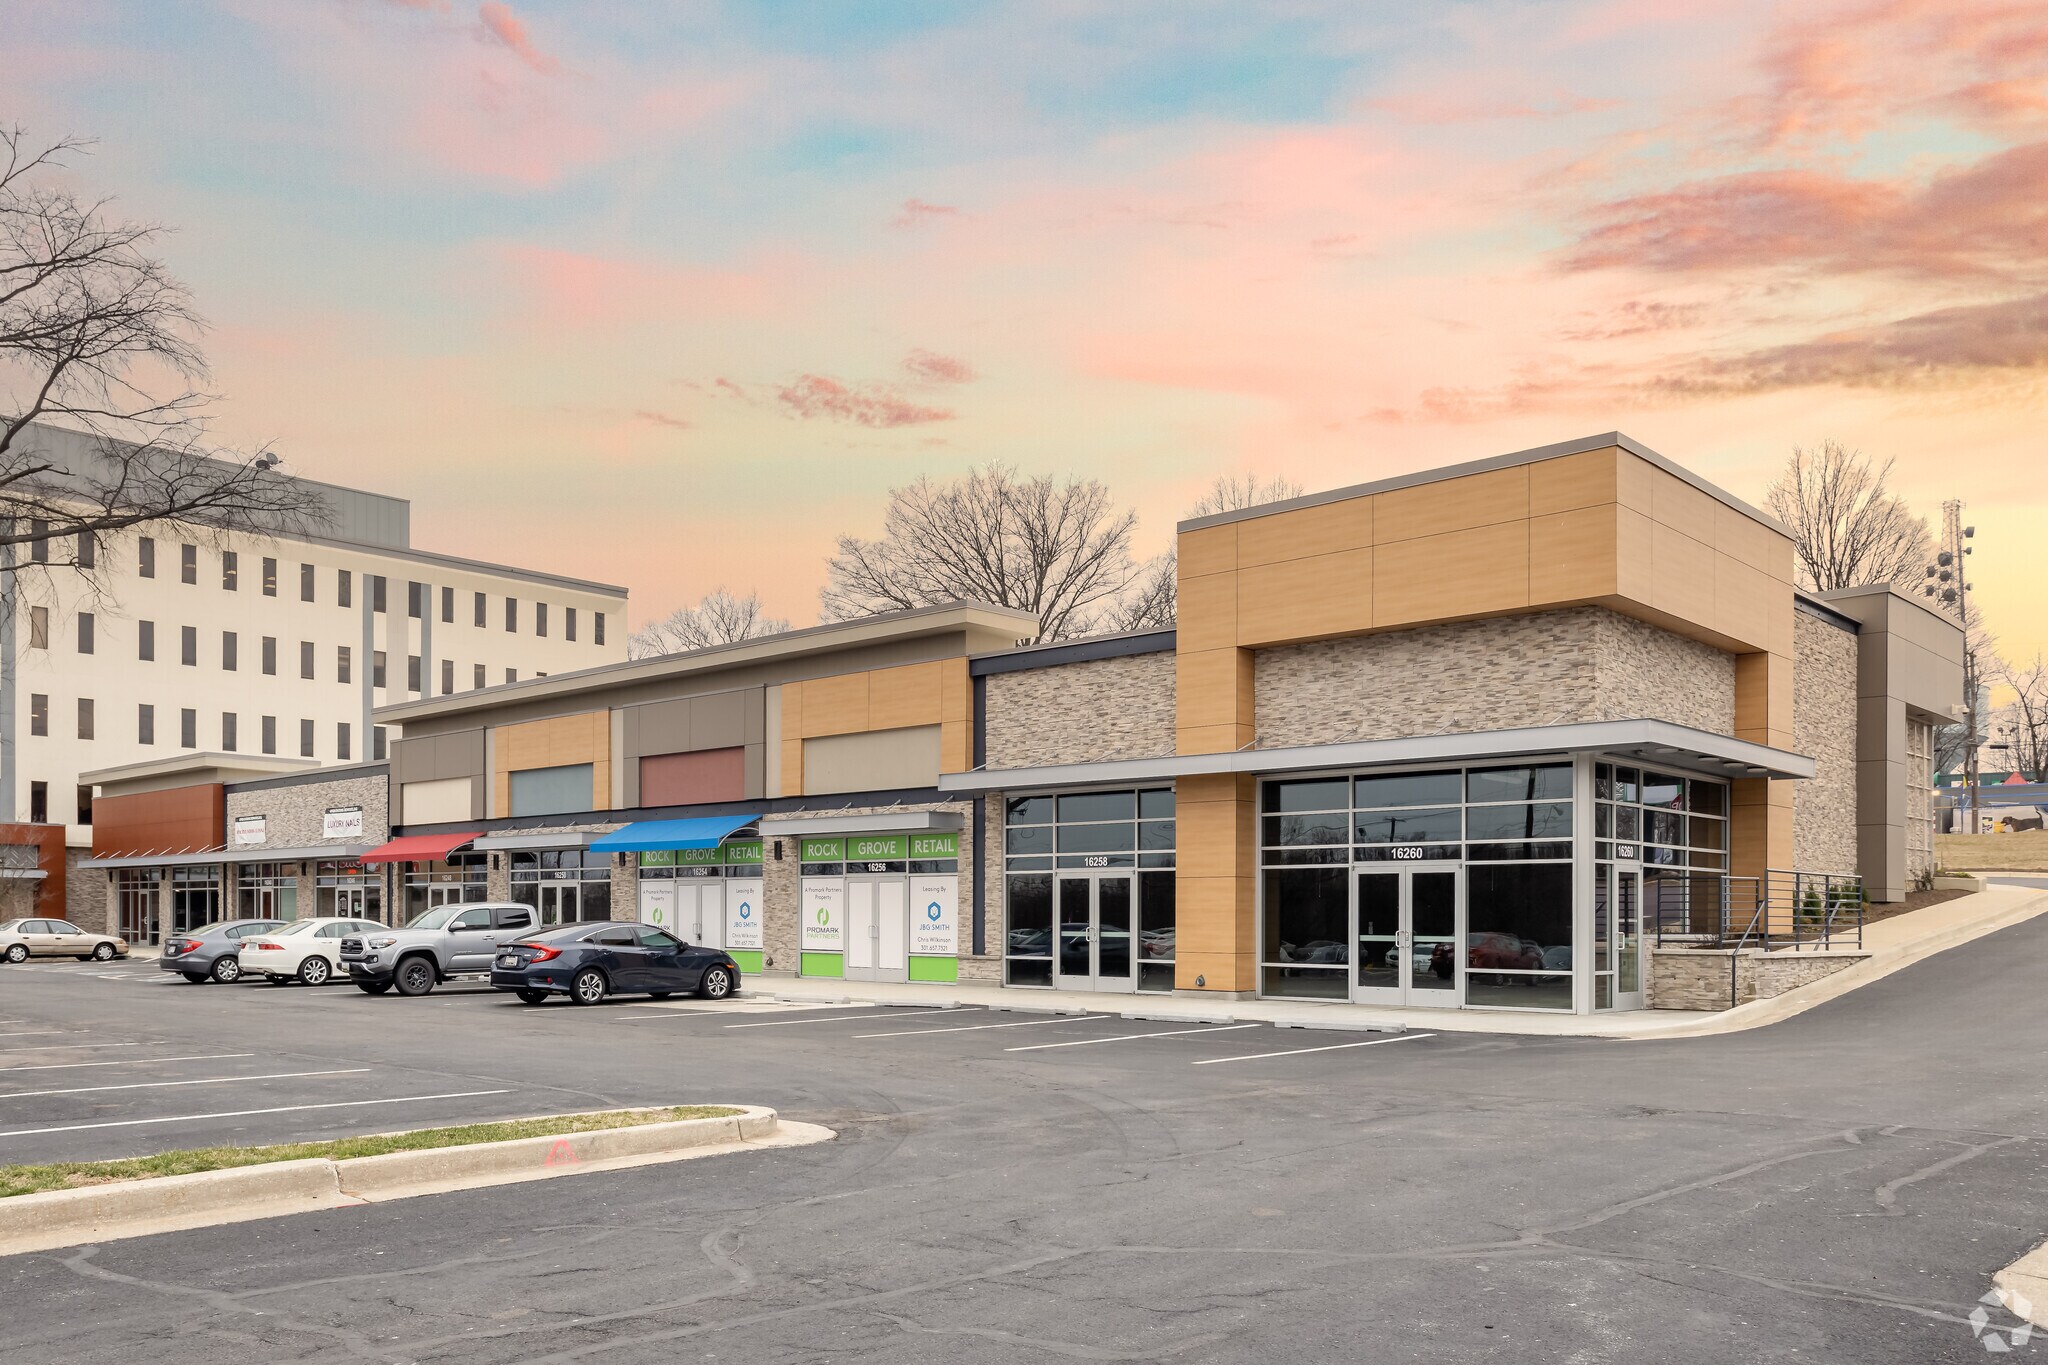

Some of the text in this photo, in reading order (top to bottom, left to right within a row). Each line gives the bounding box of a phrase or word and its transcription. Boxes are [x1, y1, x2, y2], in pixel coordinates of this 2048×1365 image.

[327, 818, 360, 829] LUXURY NAILS
[807, 838, 954, 857] ROCK GROVE RETAIL
[1391, 847, 1423, 859] 16260
[1617, 845, 1634, 858] 16260
[645, 847, 761, 862] ROCK GROVE RETAIL
[867, 862, 886, 872] 16256
[1084, 856, 1108, 867] 16258
[693, 867, 708, 876] 16254
[919, 923, 950, 931] JBG SMITH
